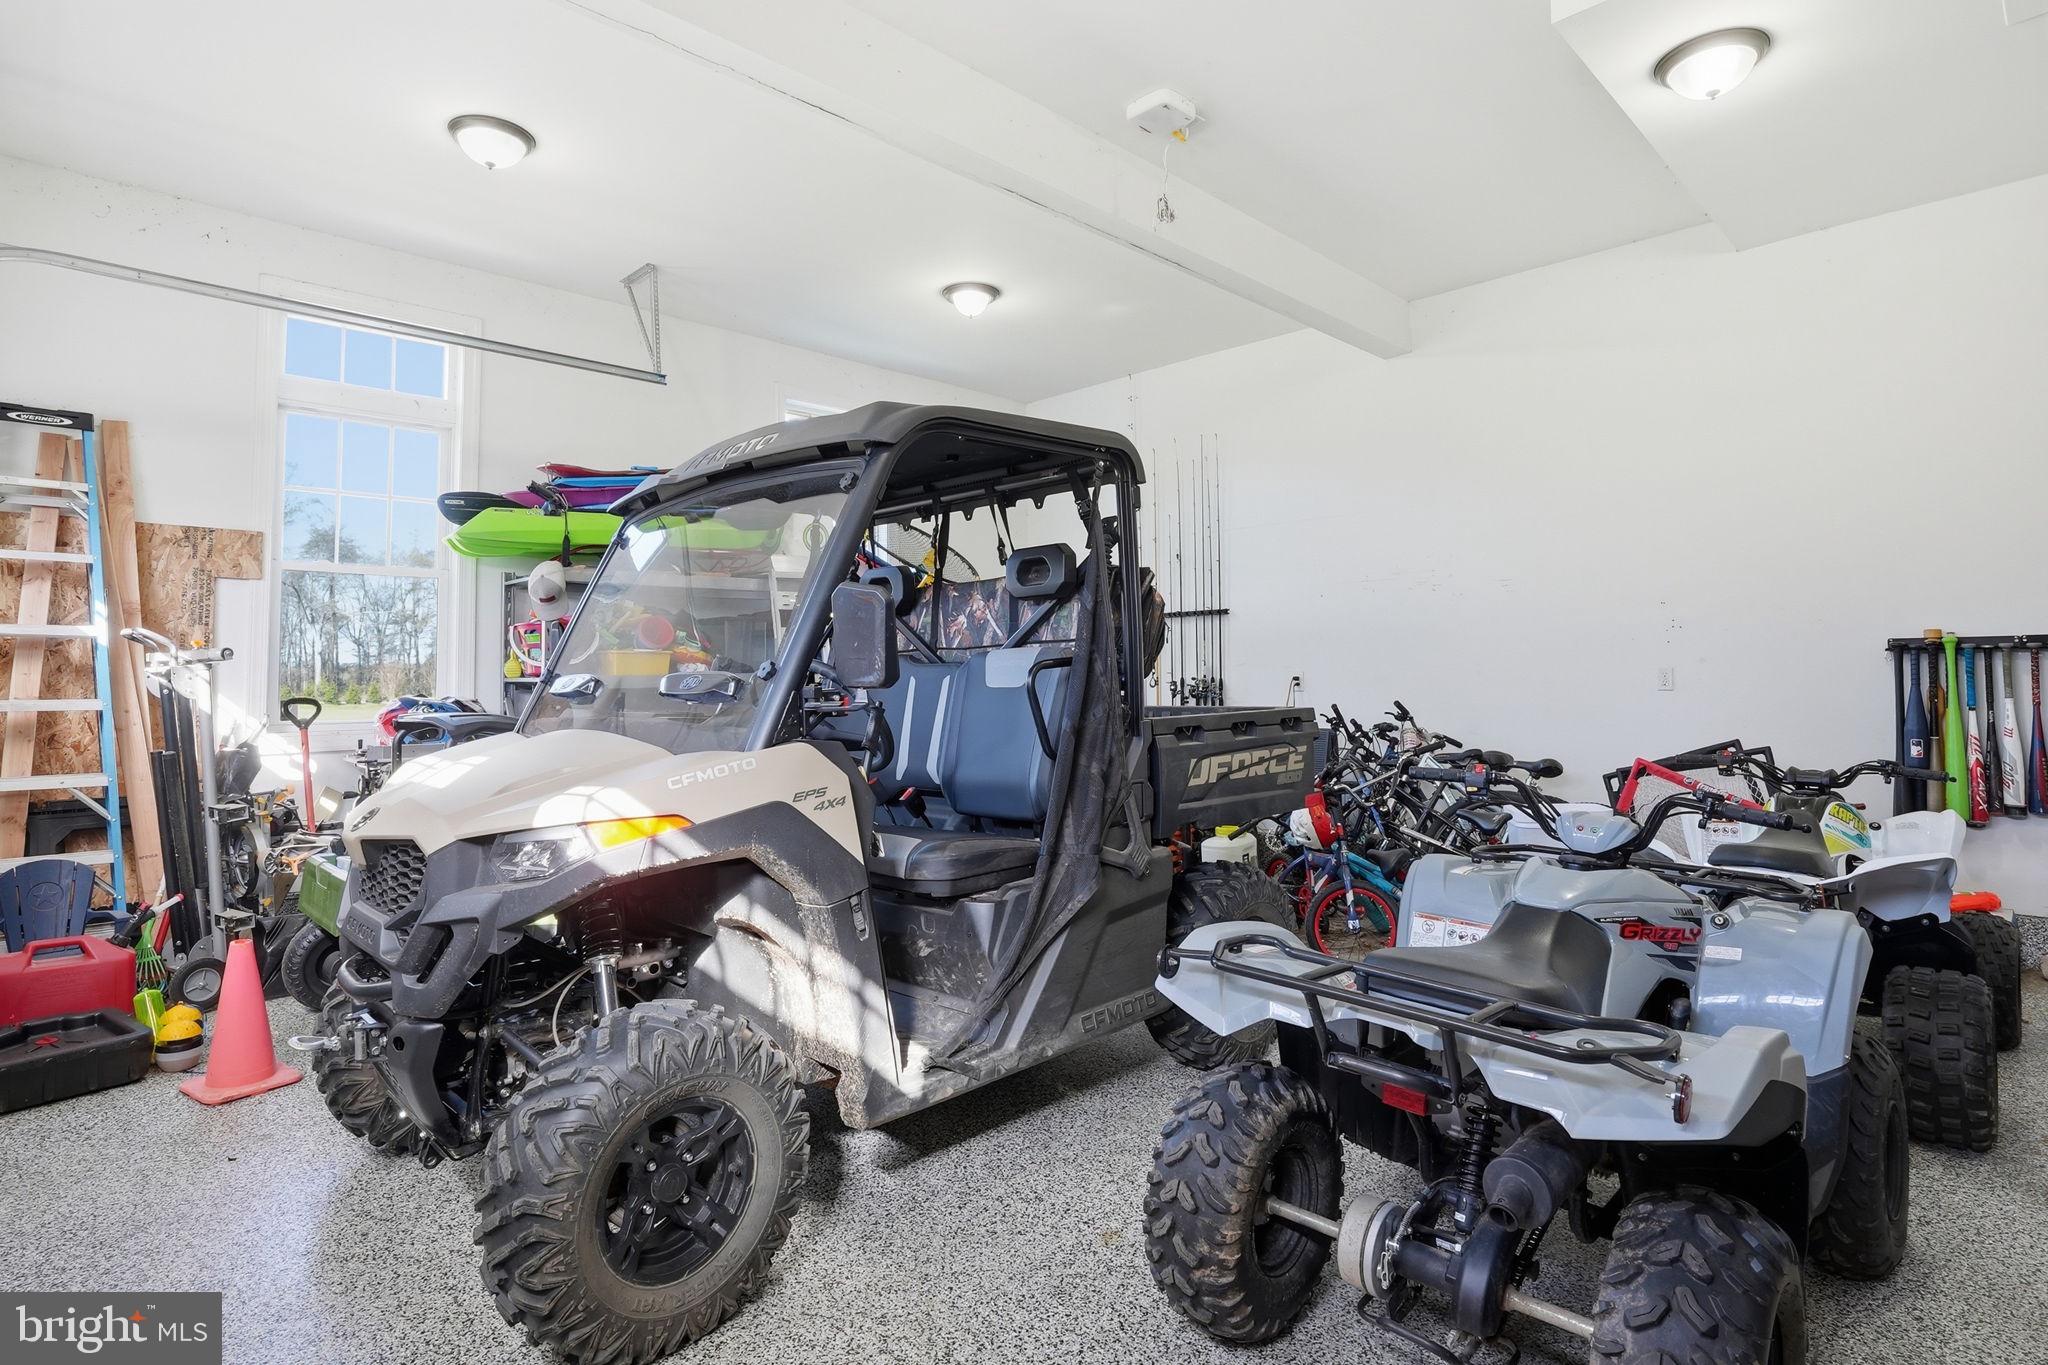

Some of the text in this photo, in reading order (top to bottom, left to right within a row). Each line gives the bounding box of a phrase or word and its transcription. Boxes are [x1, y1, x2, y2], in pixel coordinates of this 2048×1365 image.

[20, 413, 61, 423] WERNER
[666, 757, 758, 790] CFMOTO
[1188, 745, 1307, 787] UFORCE
[792, 786, 828, 803] EPS
[813, 795, 847, 812] 4X4
[1619, 922, 1702, 942] GRIZZLY
[1080, 990, 1157, 1033] CFMOTO
